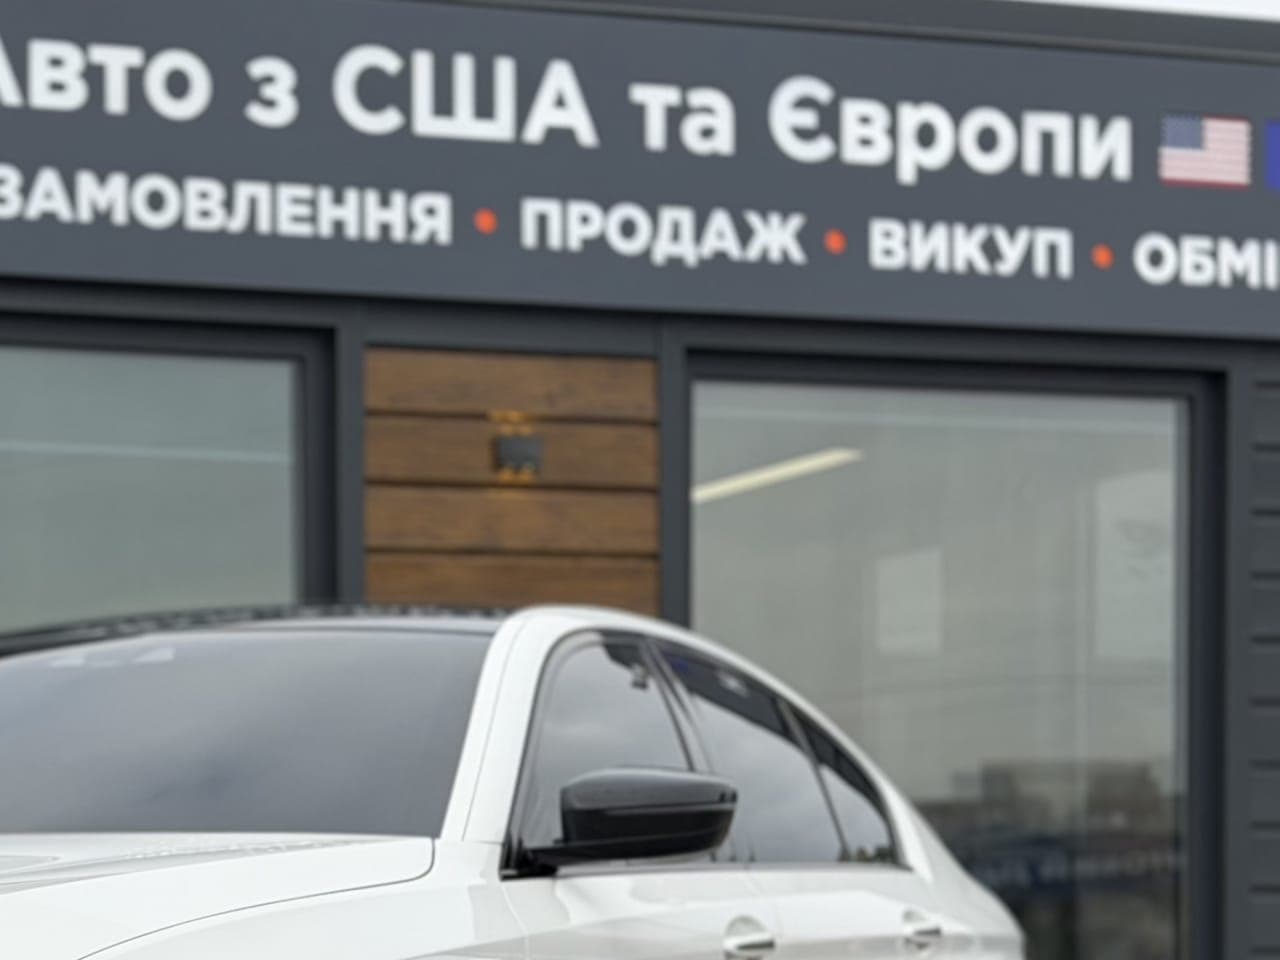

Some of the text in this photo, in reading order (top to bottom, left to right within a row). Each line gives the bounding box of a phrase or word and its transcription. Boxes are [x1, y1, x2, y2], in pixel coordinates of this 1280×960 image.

[244, 56, 300, 128] з
[332, 44, 599, 148] США
[628, 82, 736, 157] та
[767, 75, 1133, 186] Європи
[520, 196, 807, 268] ПРОДАЖ
[868, 217, 1074, 280] ВИКУП
[1132, 232, 1280, 290] ОБМІ
